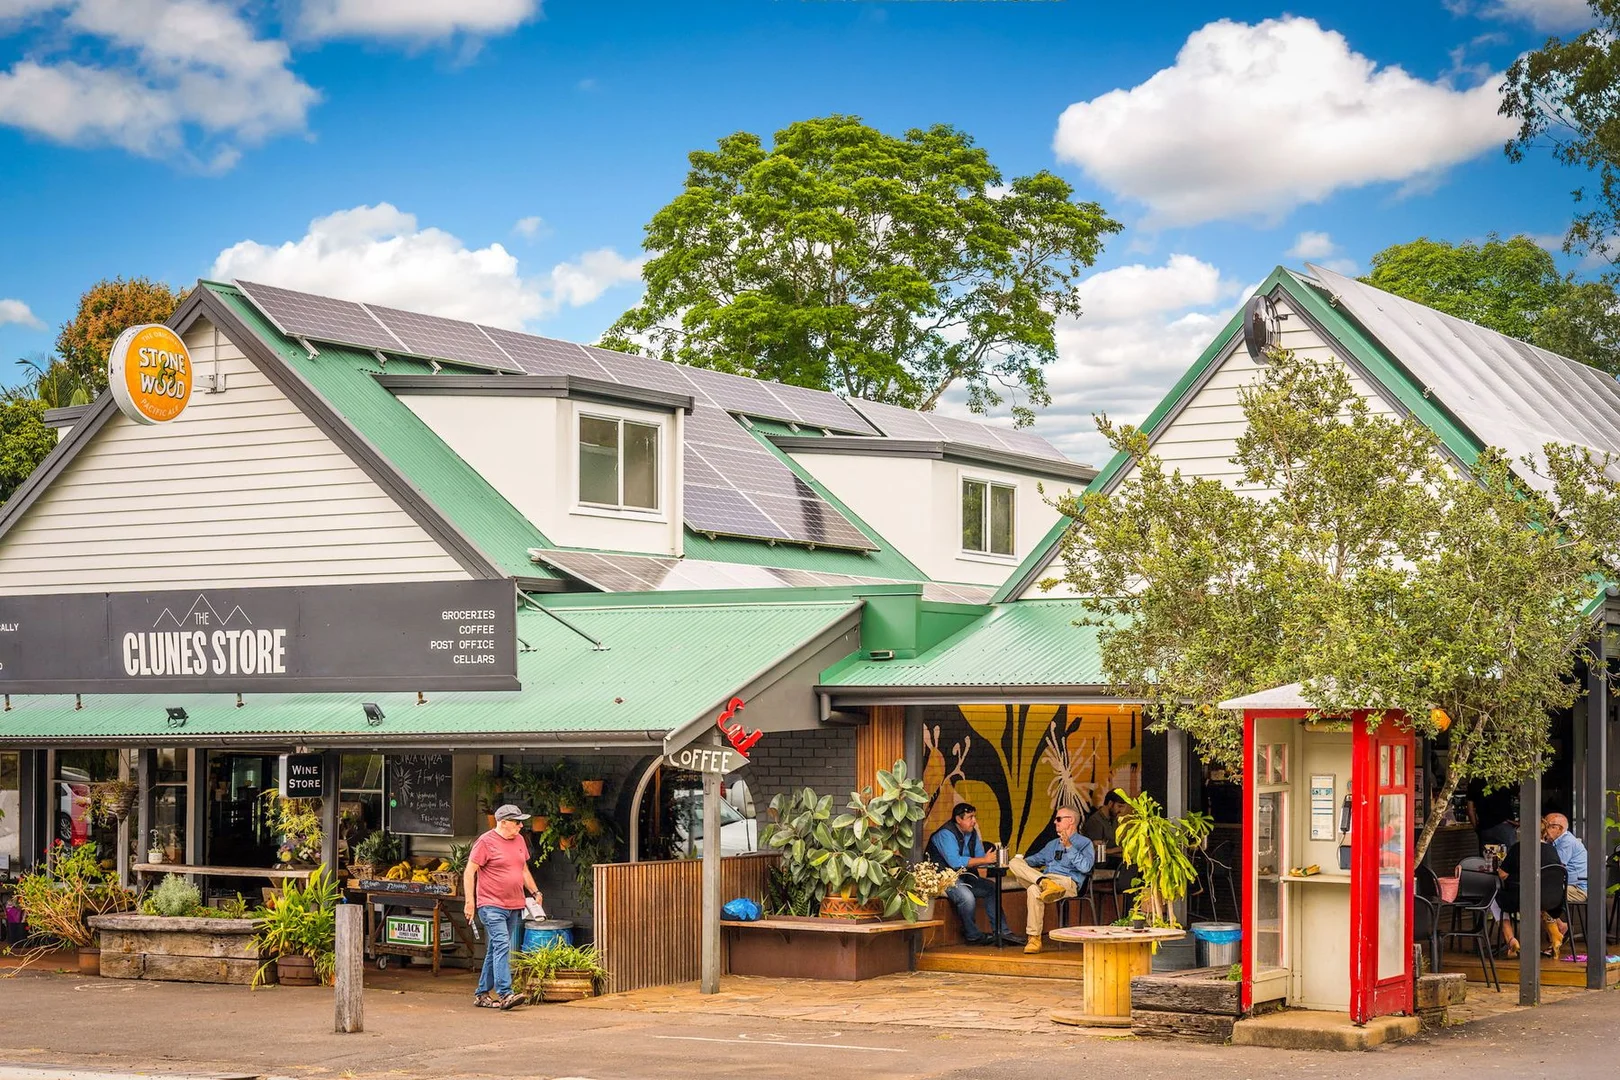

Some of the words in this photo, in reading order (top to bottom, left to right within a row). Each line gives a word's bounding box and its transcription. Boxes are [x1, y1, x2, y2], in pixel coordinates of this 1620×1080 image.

[138, 347, 187, 375] STONE
[139, 371, 185, 400] WOOD
[140, 397, 167, 417] PACIFIC
[167, 405, 179, 416] ALE
[194, 611, 209, 625] THE
[441, 609, 496, 620] GROCERIES
[0, 622, 20, 632] ALLY
[458, 624, 495, 635] COFFEE
[430, 640, 455, 650] POST
[458, 639, 495, 650] OFFICE
[122, 630, 208, 677] CLUNES
[211, 628, 287, 675] STORE
[453, 654, 495, 664] CELLARS
[668, 748, 733, 773] COFFEE
[397, 923, 420, 932] BLACK
